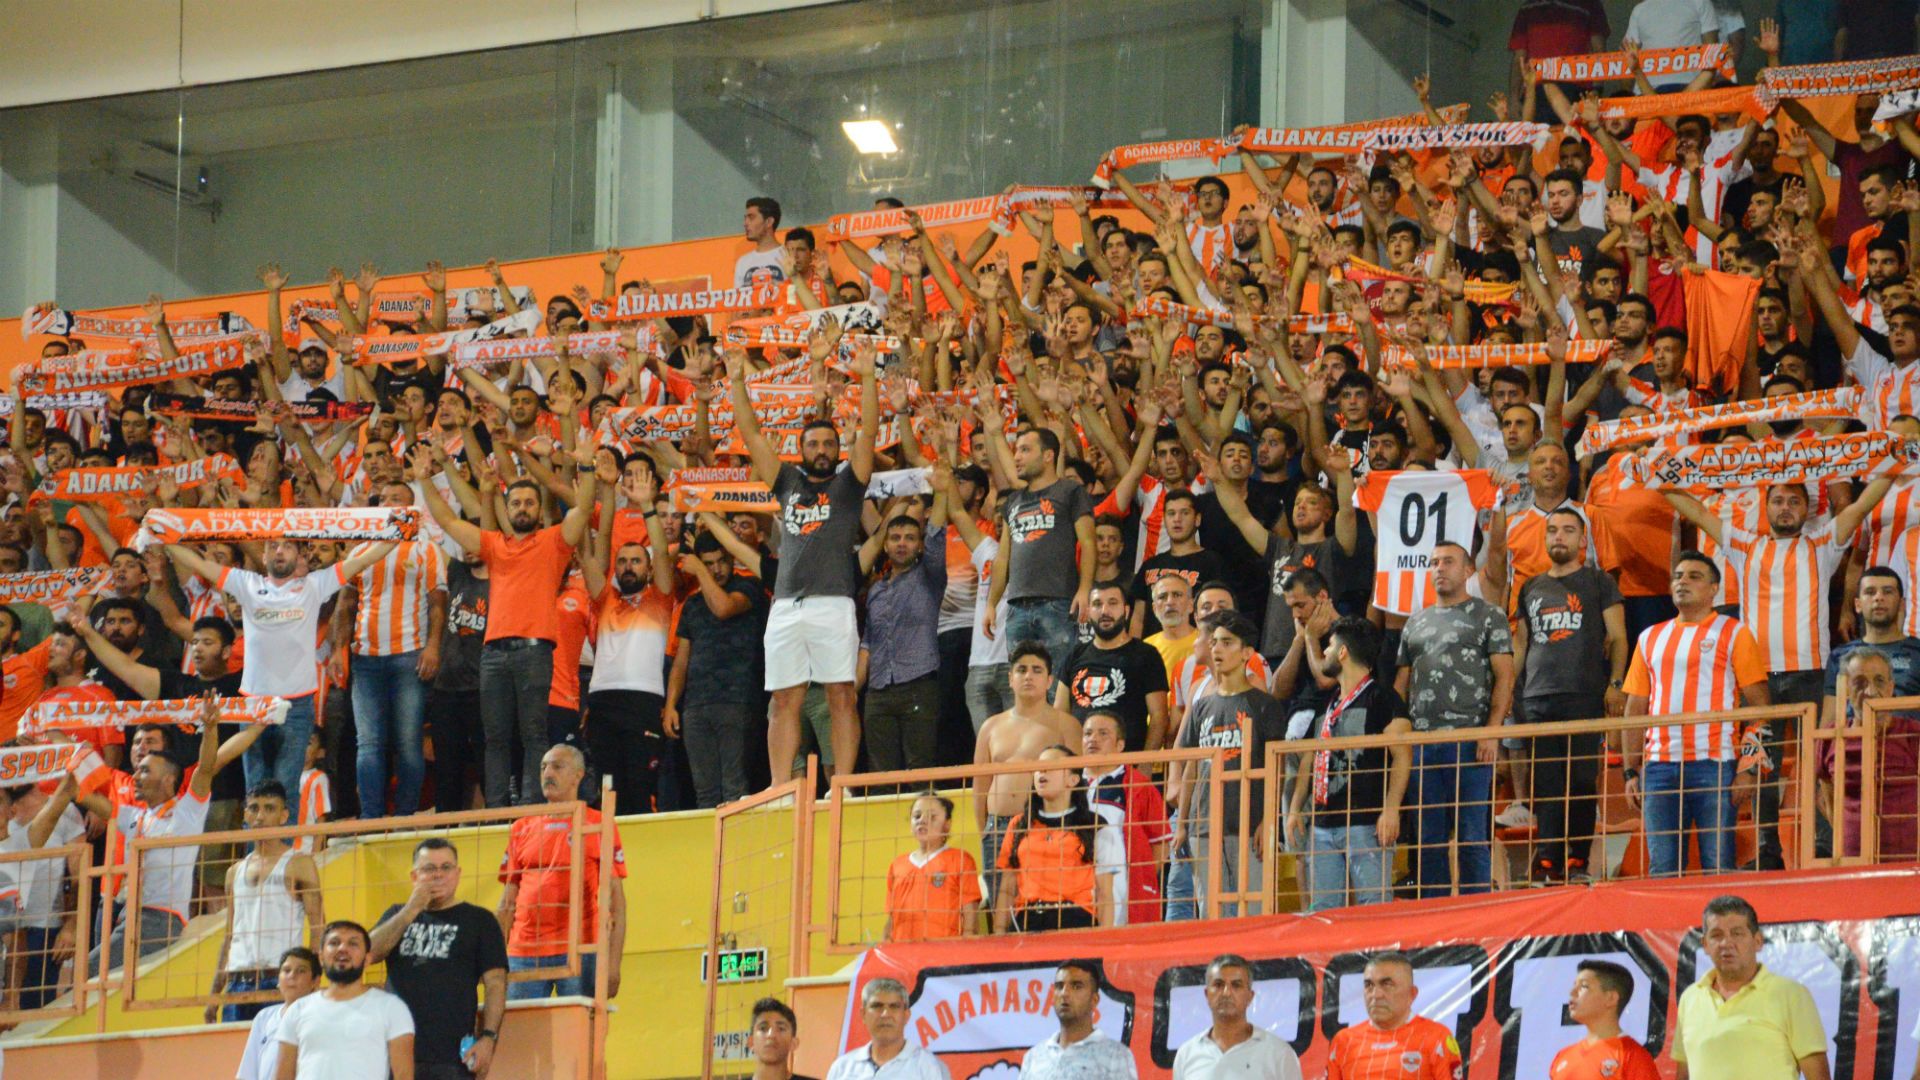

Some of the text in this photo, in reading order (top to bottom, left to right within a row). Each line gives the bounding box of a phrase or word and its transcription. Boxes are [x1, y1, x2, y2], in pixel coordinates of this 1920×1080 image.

[1559, 53, 1701, 80] ADANSPOR
[1253, 128, 1366, 147] ADANASP
[851, 199, 992, 231] ADANAPORLUYUZ
[378, 299, 432, 312] ADANASR
[616, 287, 753, 317] ADANASPOR
[368, 341, 419, 354] ADANASPOR
[55, 351, 208, 390] ADANASPOR
[1699, 432, 1889, 472] ADANASPOR
[66, 459, 205, 494] ADANAOR
[681, 467, 747, 483] ADANASPOR
[712, 490, 776, 504] ADANASP
[187, 517, 386, 532] ADANASPOR
[1399, 491, 1449, 547] 01
[1397, 555, 1432, 569] MUR
[54, 697, 247, 716] ADANASPR
[914, 978, 1101, 1048] ADANAS
